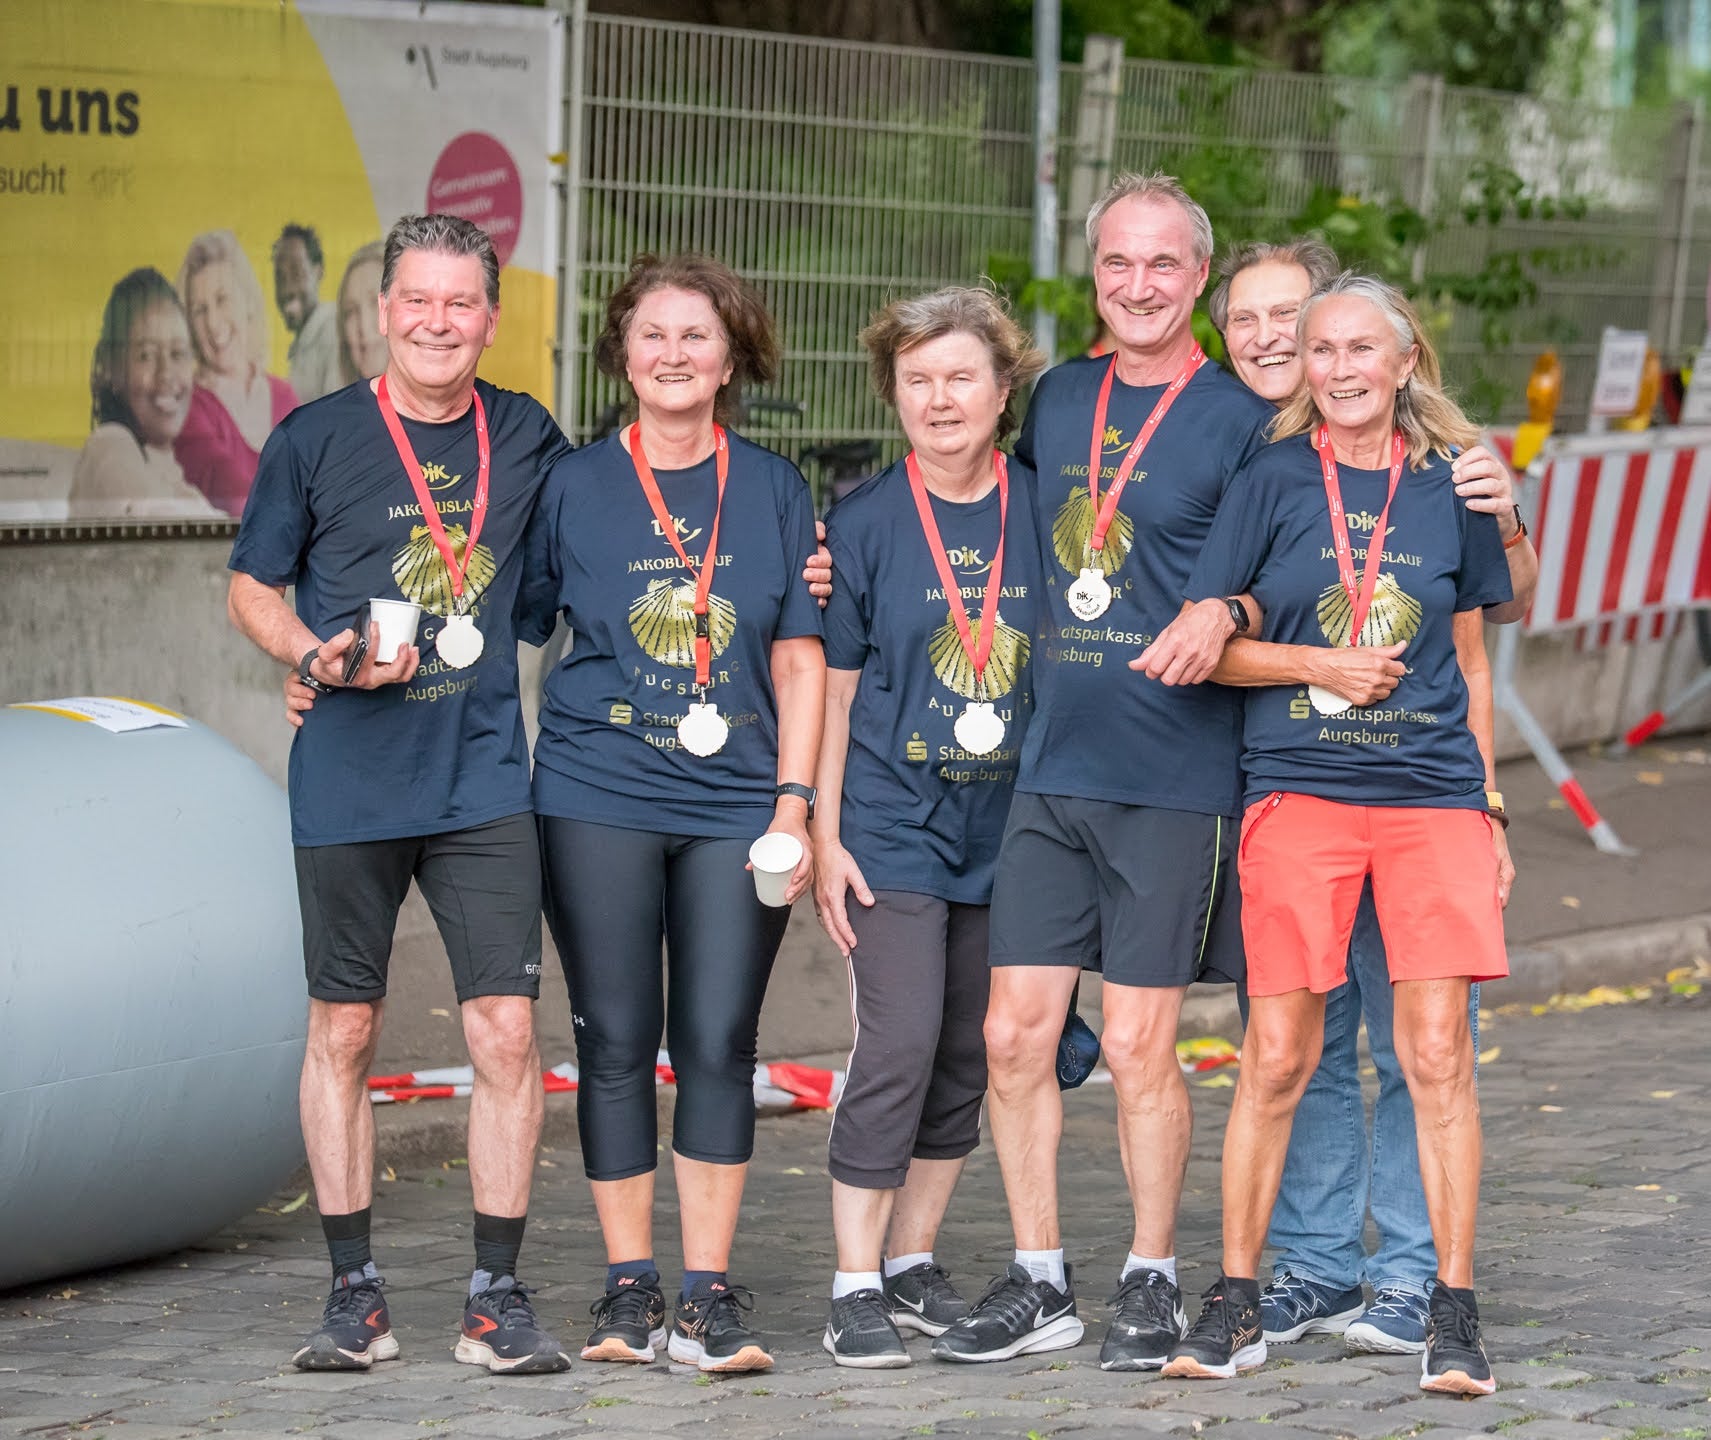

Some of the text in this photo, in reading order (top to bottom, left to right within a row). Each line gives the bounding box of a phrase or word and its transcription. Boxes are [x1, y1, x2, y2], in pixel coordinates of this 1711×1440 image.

[37, 87, 139, 136] uns
[388, 499, 489, 521] JAKOUSLA
[627, 555, 733, 575] JAKOBUSLUF
[1320, 547, 1423, 568] JAOBSLAUF
[1318, 727, 1400, 749] Augsburg
